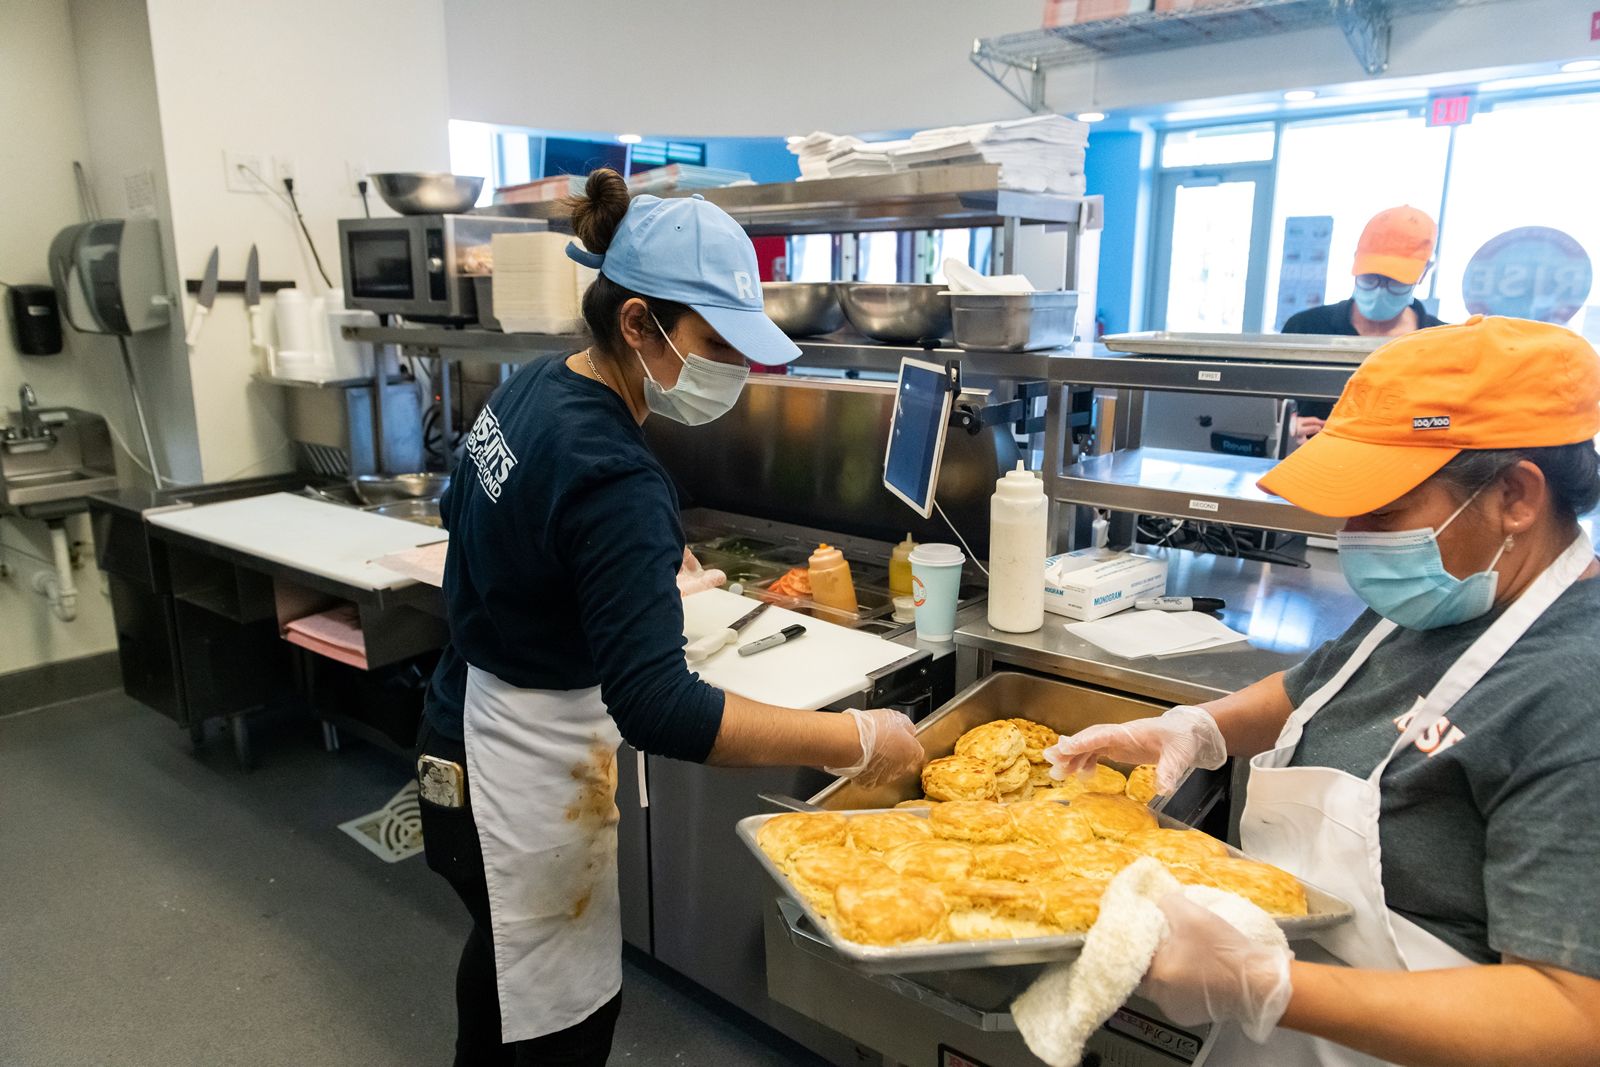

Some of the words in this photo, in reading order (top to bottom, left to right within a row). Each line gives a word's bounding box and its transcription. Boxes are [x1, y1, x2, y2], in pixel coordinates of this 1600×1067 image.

[1432, 97, 1470, 125] EXIT
[1200, 372, 1219, 380] FIRST
[1413, 417, 1450, 428] 100/100
[1191, 501, 1217, 510] SECOND
[1093, 591, 1122, 606] MONOGRAM
